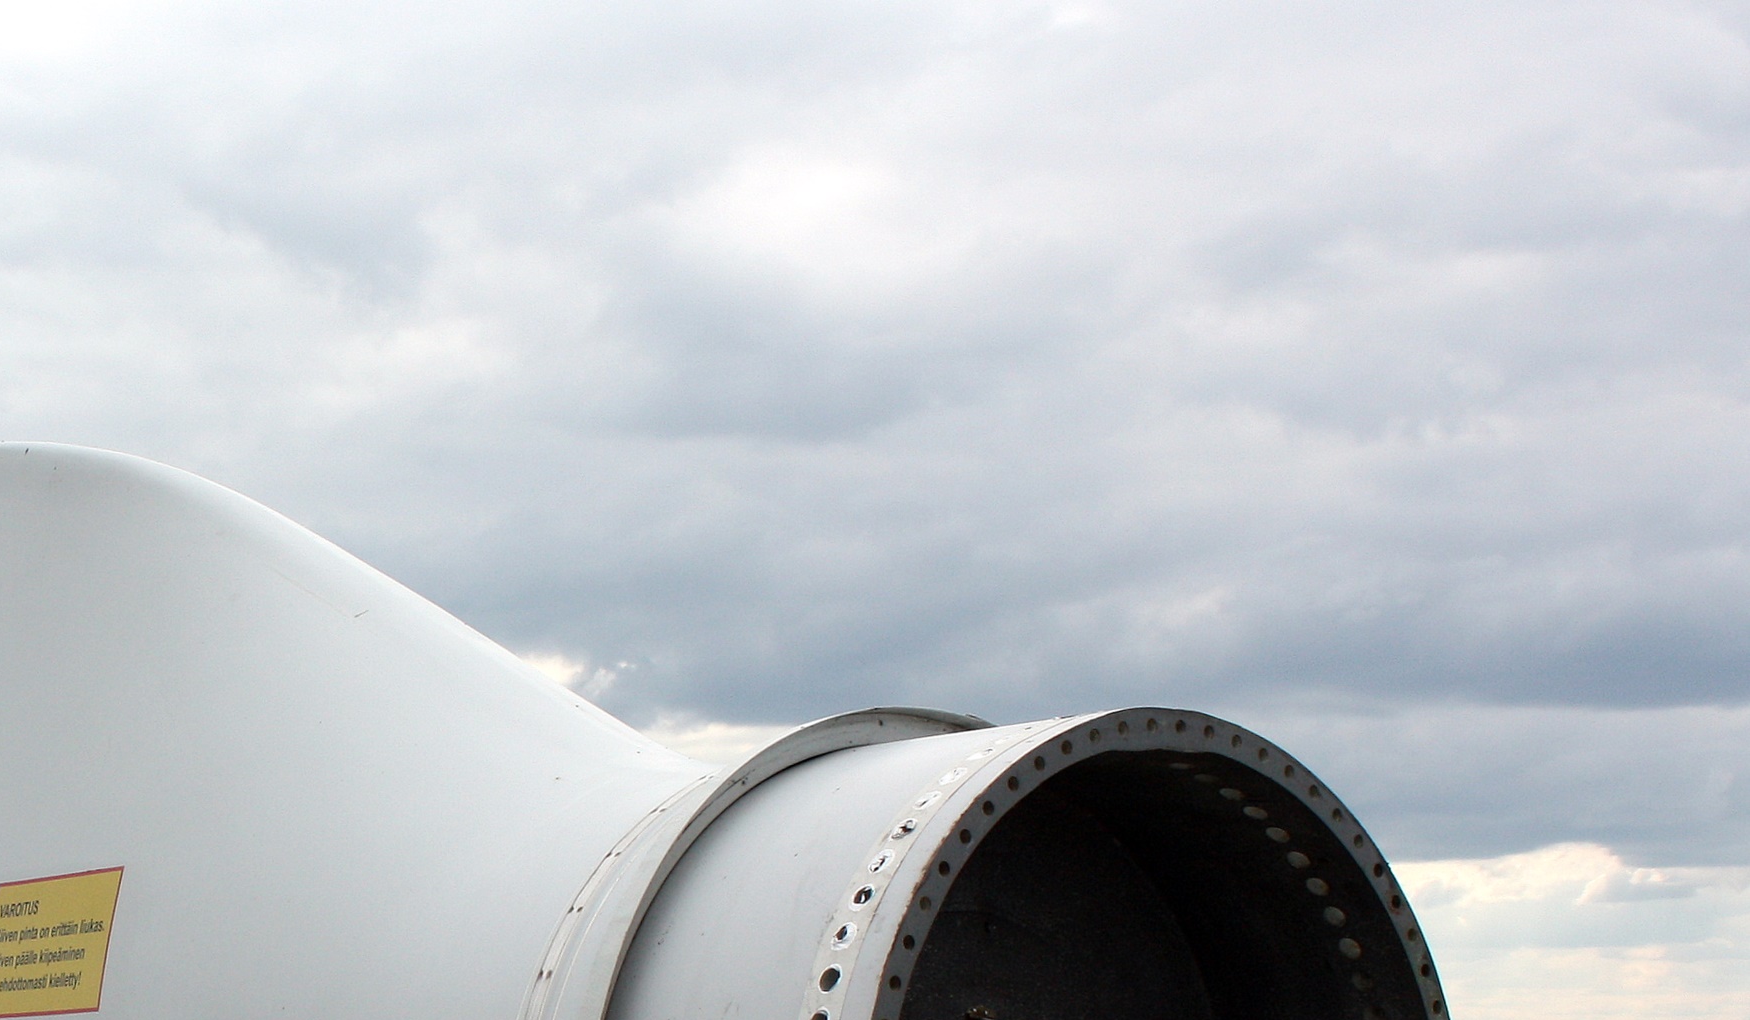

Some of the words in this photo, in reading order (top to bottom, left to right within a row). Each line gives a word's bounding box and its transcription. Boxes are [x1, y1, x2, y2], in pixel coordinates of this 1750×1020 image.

[0, 900, 39, 918] VAROITUS
[19, 924, 38, 944] pinta
[39, 926, 50, 938] on
[79, 918, 105, 934] liukas.
[15, 950, 38, 969] päälle
[38, 946, 85, 965] kiipeäminen
[49, 971, 82, 990] kielletty!
